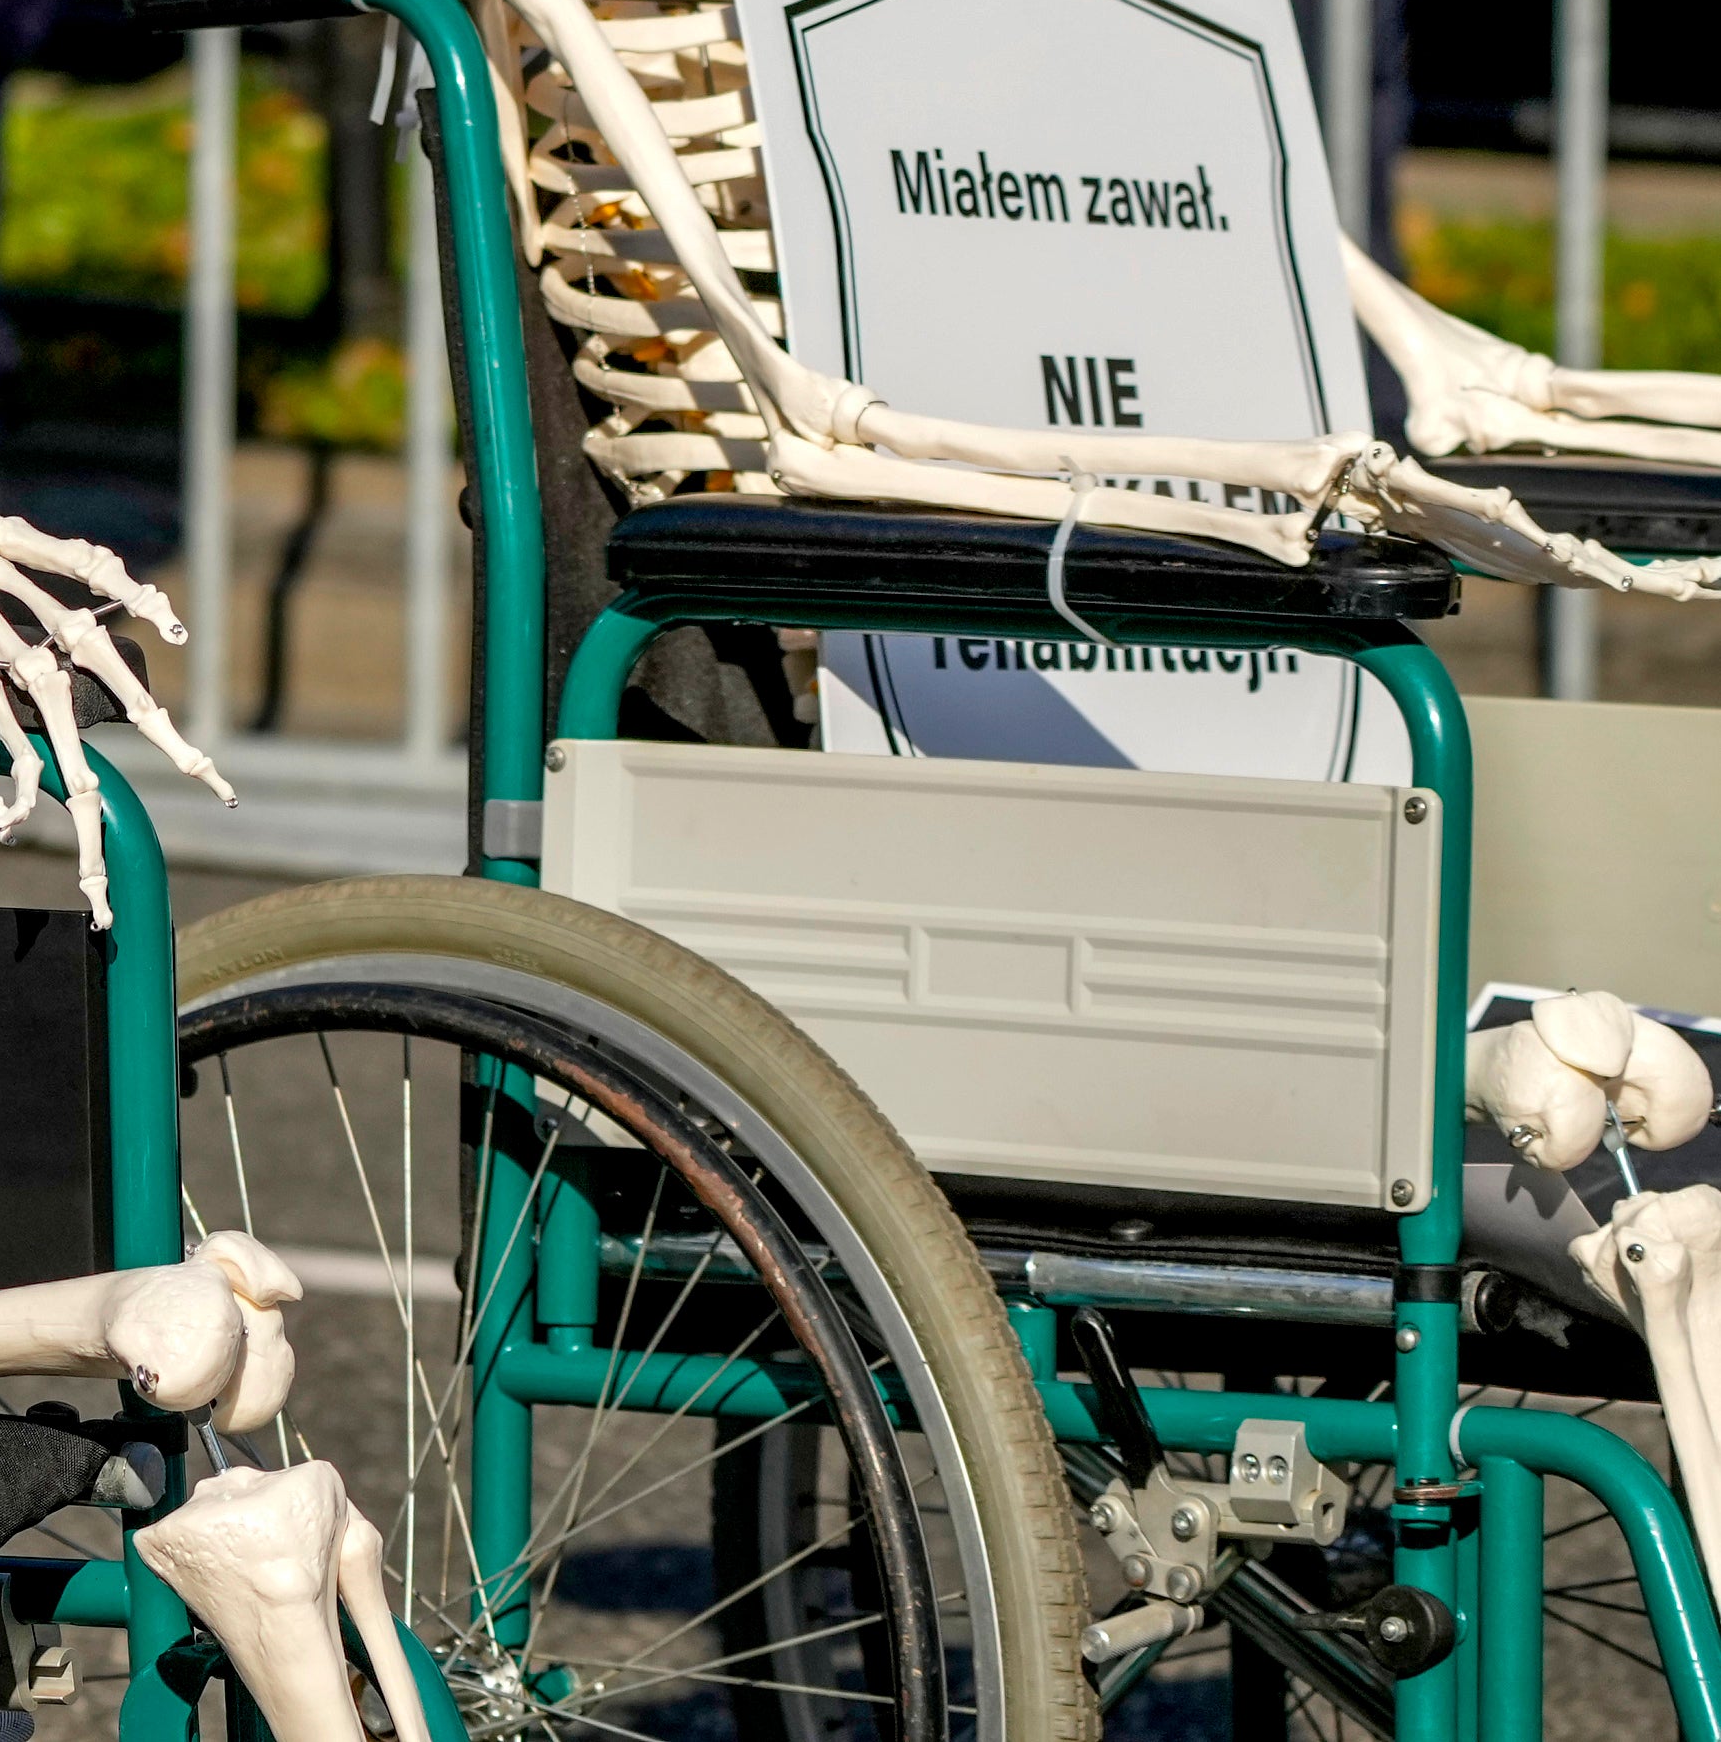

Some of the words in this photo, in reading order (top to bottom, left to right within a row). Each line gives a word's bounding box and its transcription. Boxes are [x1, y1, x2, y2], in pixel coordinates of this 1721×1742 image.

[890, 149, 1070, 223] Miałem
[1081, 164, 1230, 231] zawał.
[1040, 354, 1143, 428] NIE
